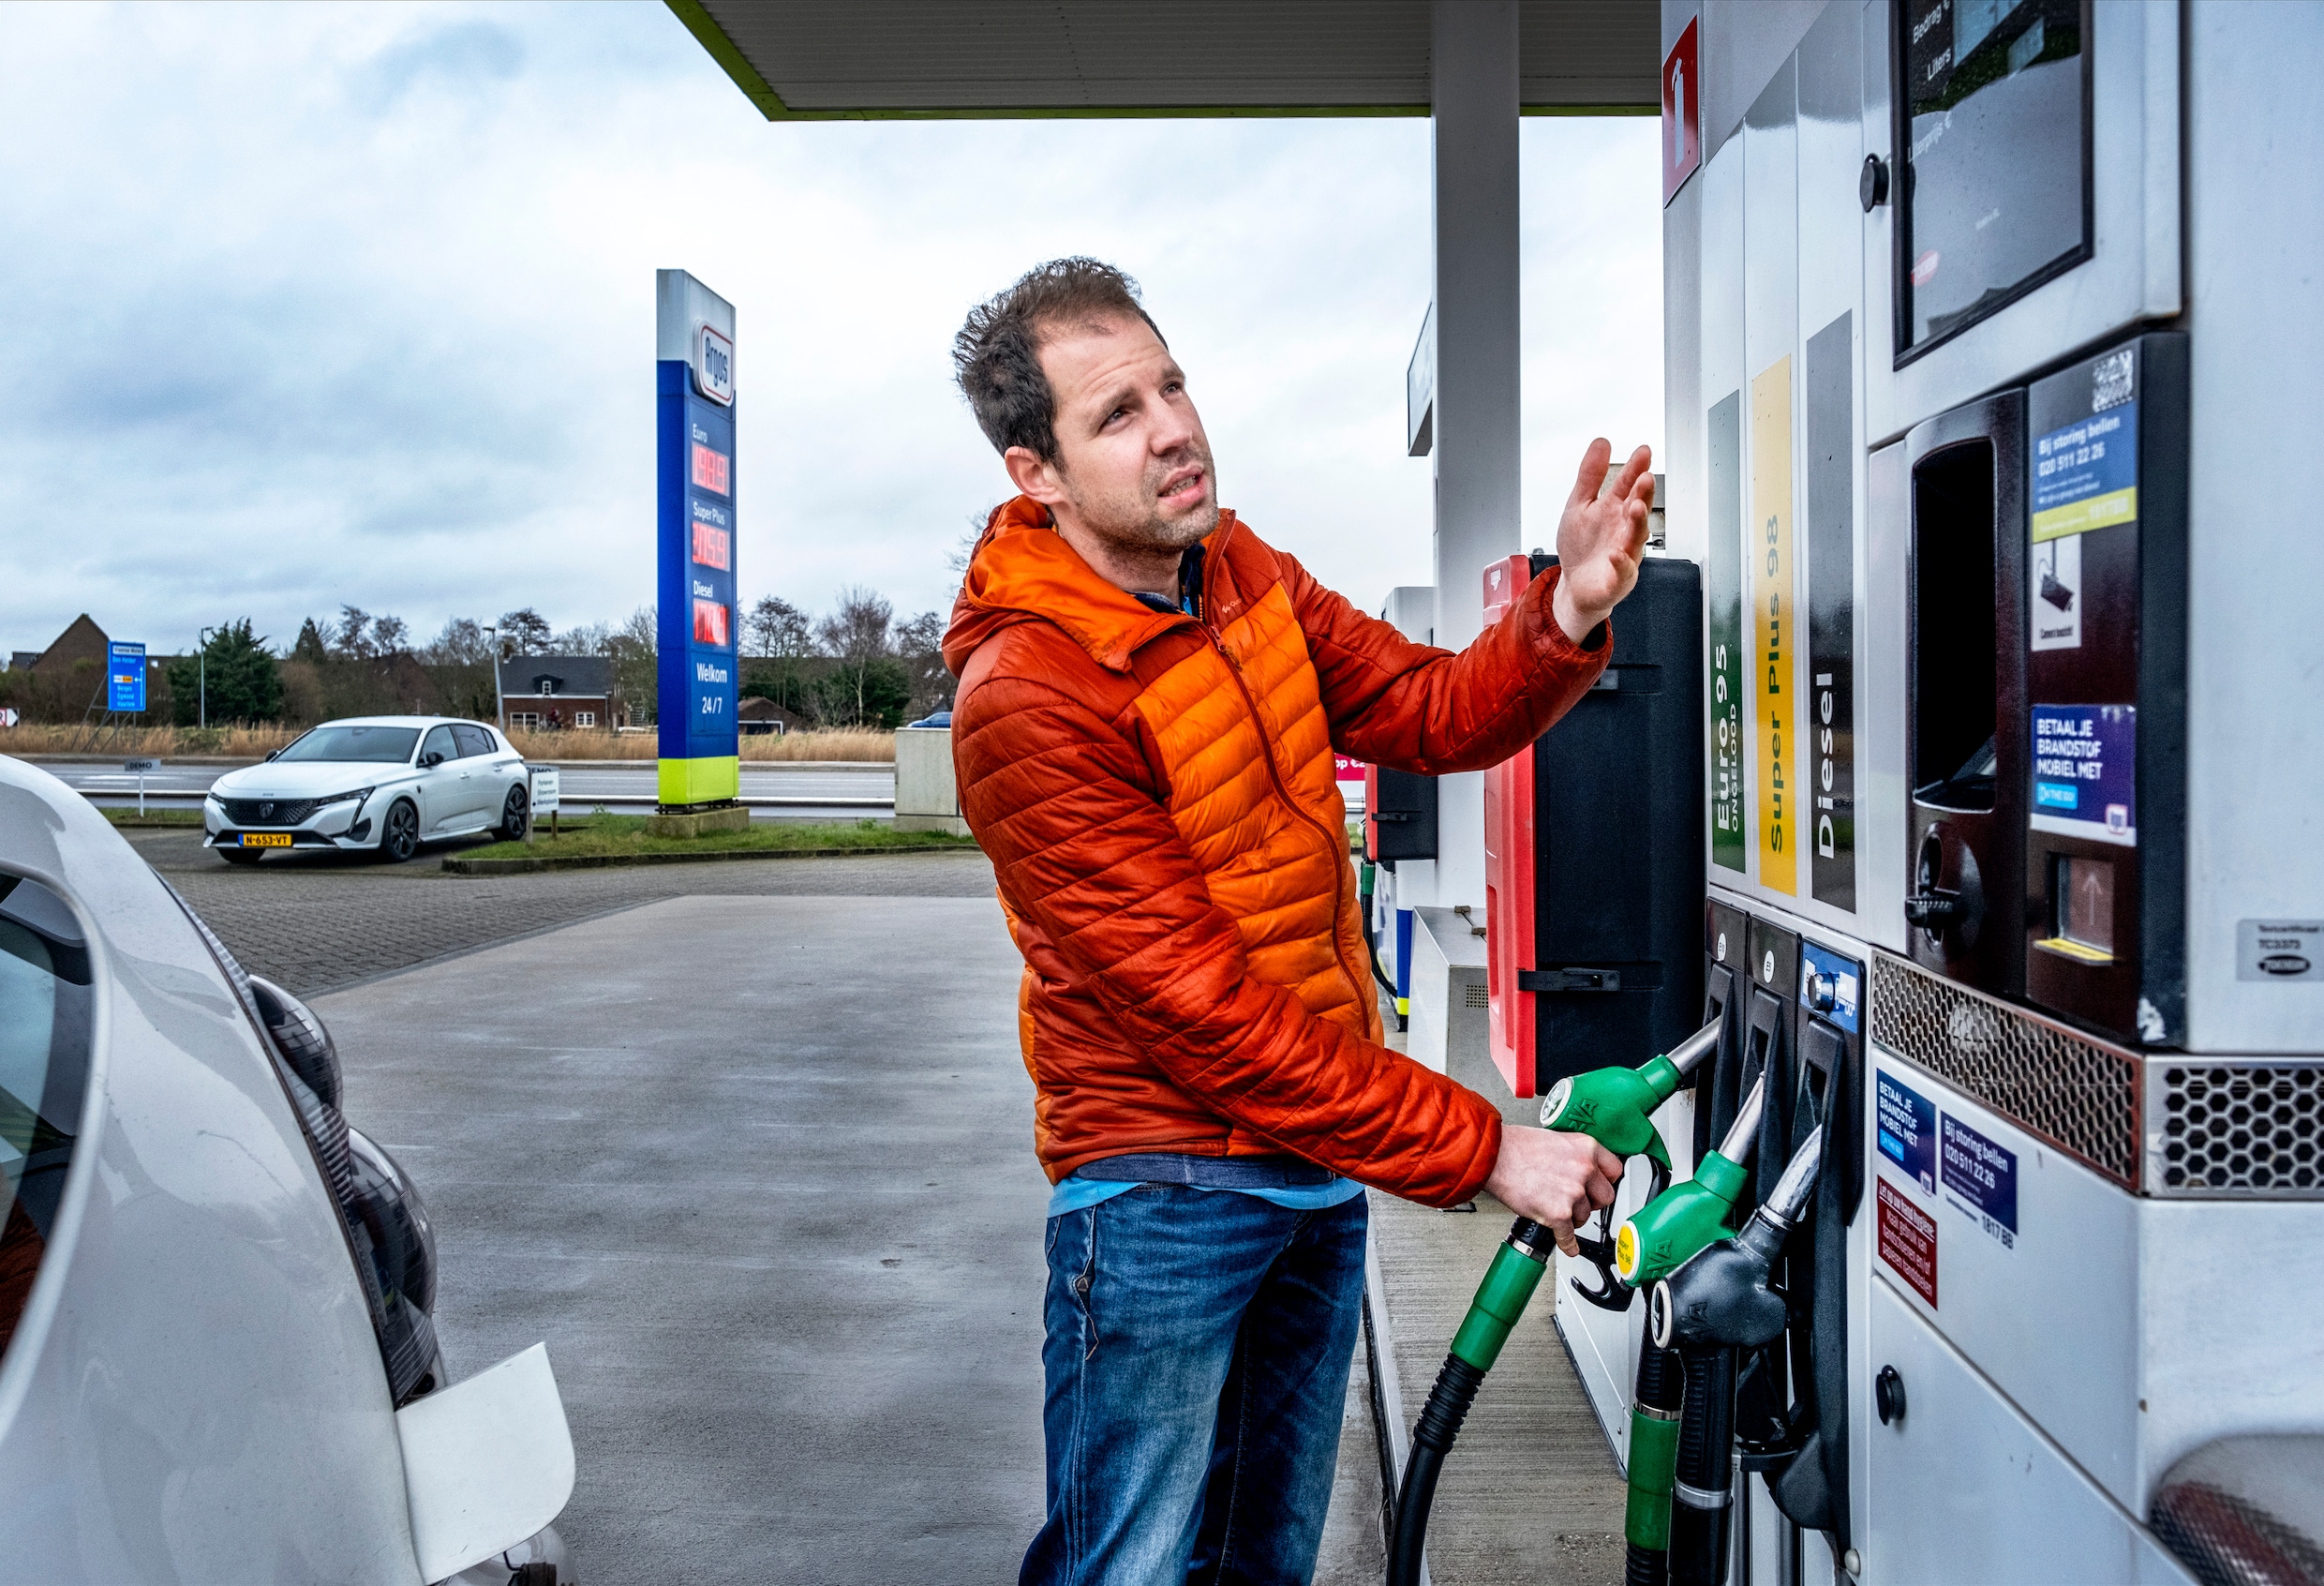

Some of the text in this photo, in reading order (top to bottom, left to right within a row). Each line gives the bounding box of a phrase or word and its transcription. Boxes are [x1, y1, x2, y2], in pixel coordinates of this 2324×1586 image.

[1913, 4, 1943, 44] Bedrag
[1927, 48, 1951, 81] Liters
[705, 336, 728, 388] Argos
[693, 424, 708, 442] Euro
[2038, 416, 2121, 456] Bij storing bellen
[2038, 457, 2056, 477] 020
[2076, 446, 2091, 465] 22
[2091, 441, 2105, 460] 26
[693, 501, 725, 525] Super Plus
[693, 579, 713, 598] Diesel
[696, 662, 728, 684] Welkom
[1766, 514, 1784, 854] Super Plus 98
[701, 696, 723, 714] 24/7
[1716, 644, 1730, 830] Euro 95
[2036, 718, 2093, 738] BETAAL JE
[2036, 738, 2102, 758] BRANDSTOF
[129, 761, 152, 770] DEMO
[1730, 702, 1738, 833] ONGELOOD
[1816, 672, 1835, 860] Diesel
[2036, 757, 2103, 780] MOBIEL MET
[246, 835, 287, 845] N-653-VT
[1879, 1081, 1914, 1114] BETAAL JE
[1879, 1096, 1918, 1131] BRANDSTOF
[1879, 1110, 1918, 1148] MOBIEL MET
[1944, 1119, 2008, 1173] Bij storing bellen
[1944, 1144, 1959, 1165] 020
[1959, 1154, 1973, 1175] 511
[1974, 1162, 1984, 1182] 22
[1985, 1170, 1996, 1190] 26
